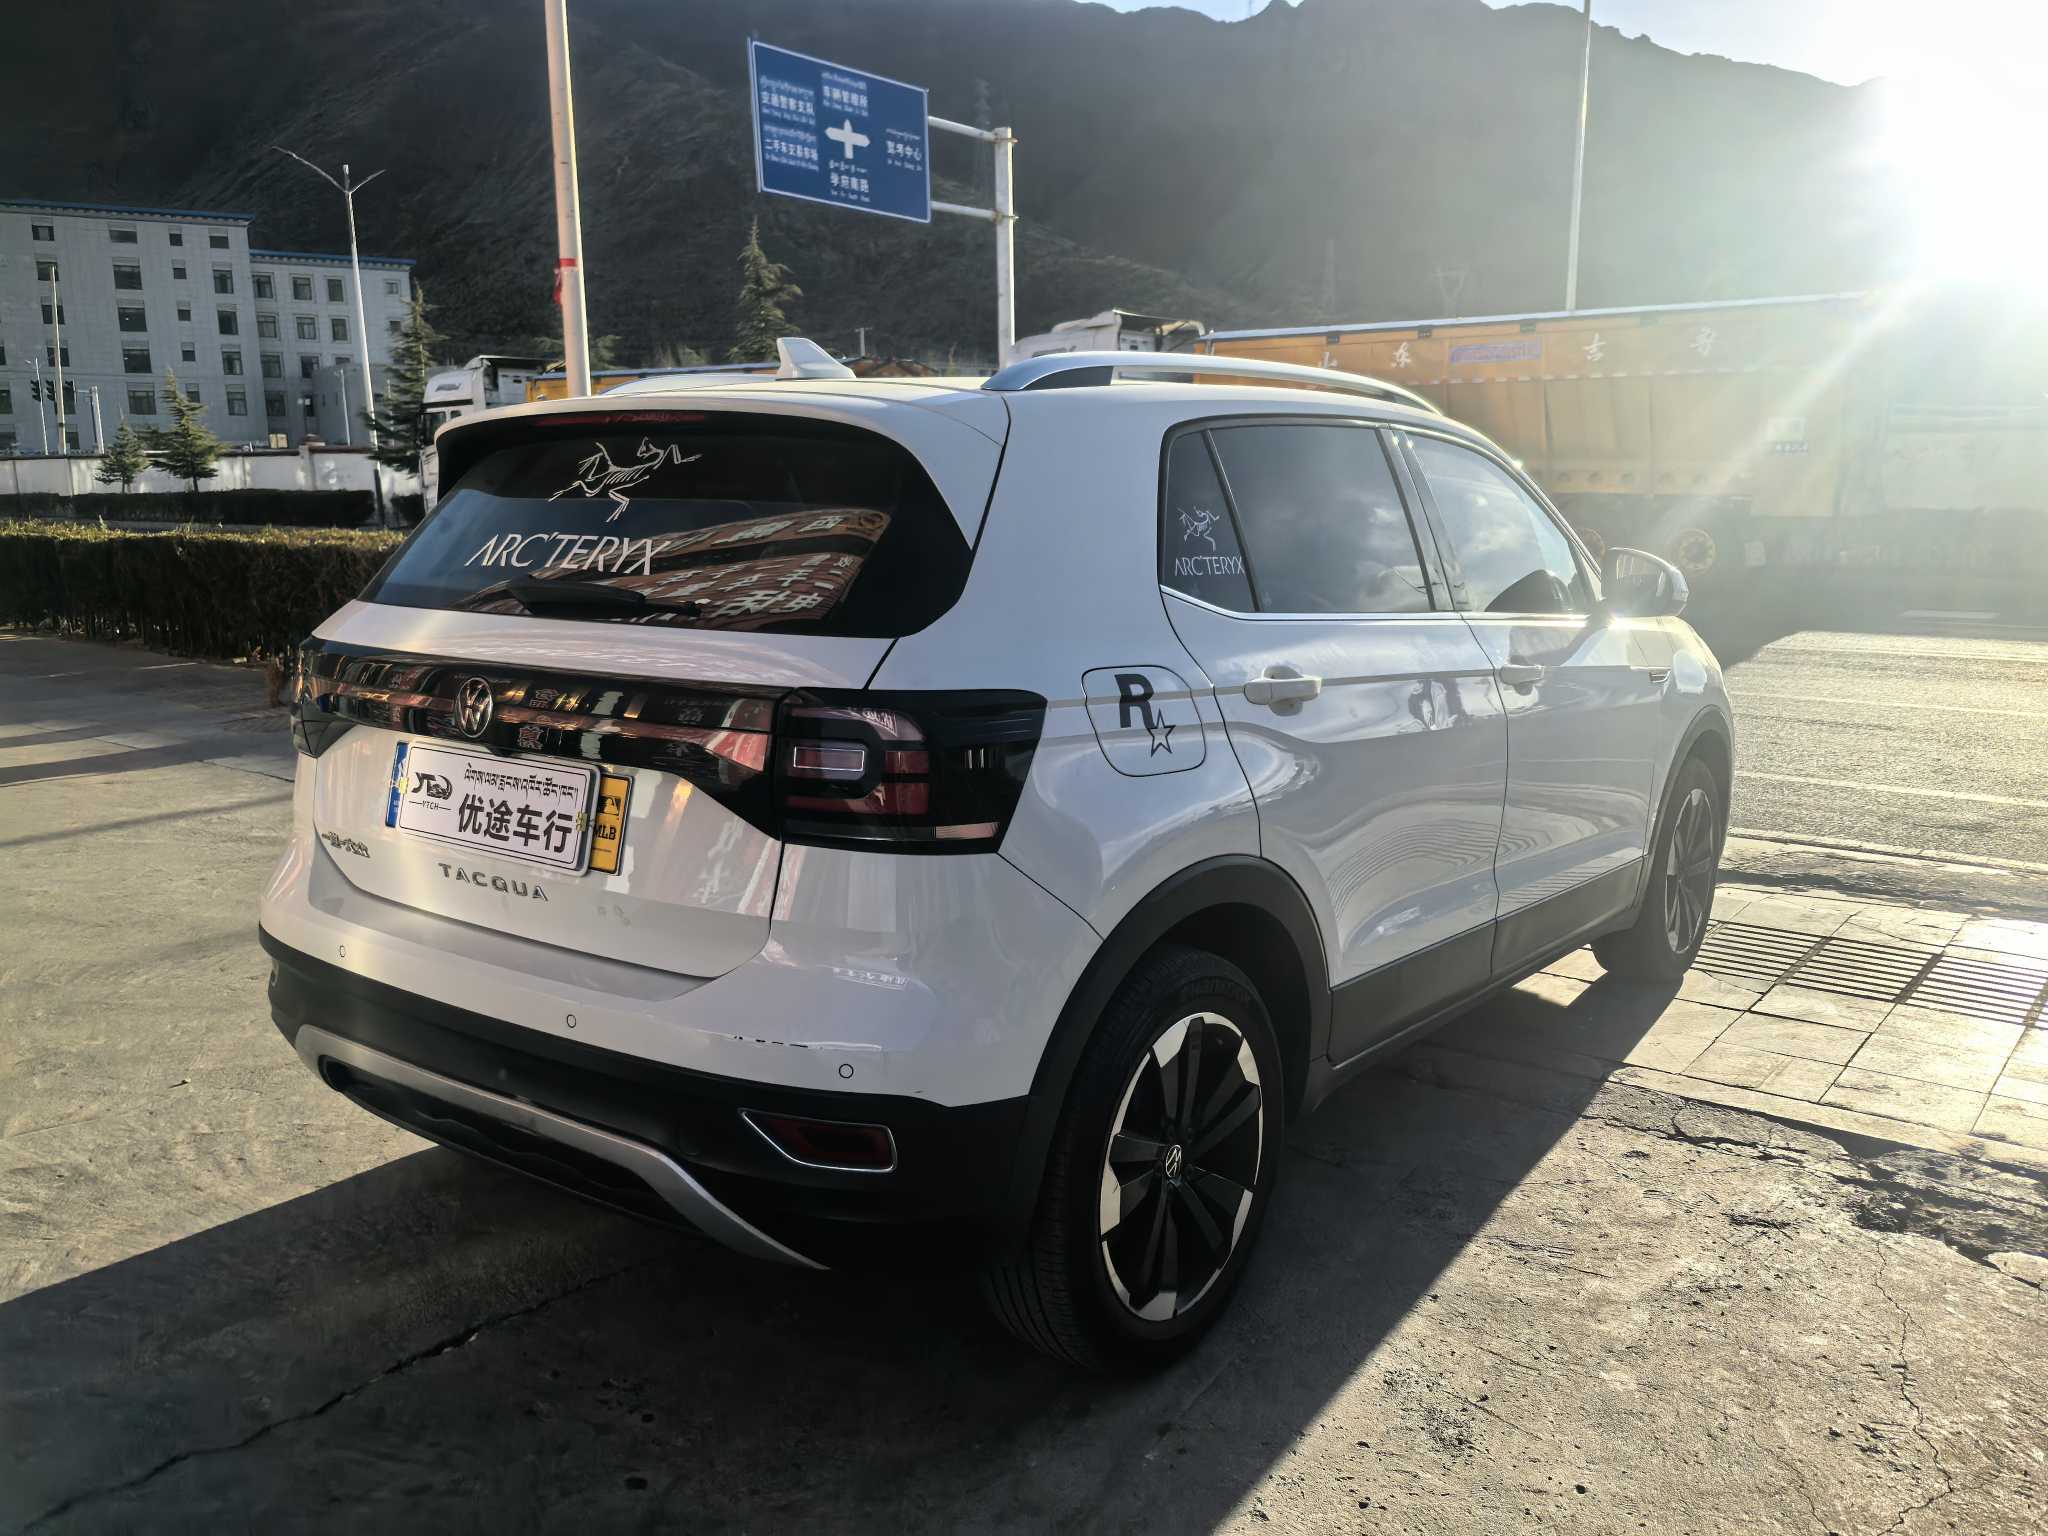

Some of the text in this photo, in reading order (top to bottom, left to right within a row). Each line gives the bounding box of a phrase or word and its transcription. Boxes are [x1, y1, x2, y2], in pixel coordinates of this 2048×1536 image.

[1114, 673, 1156, 736] R
[458, 793, 573, 853] 优途车行
[438, 862, 549, 902] TACQUA
